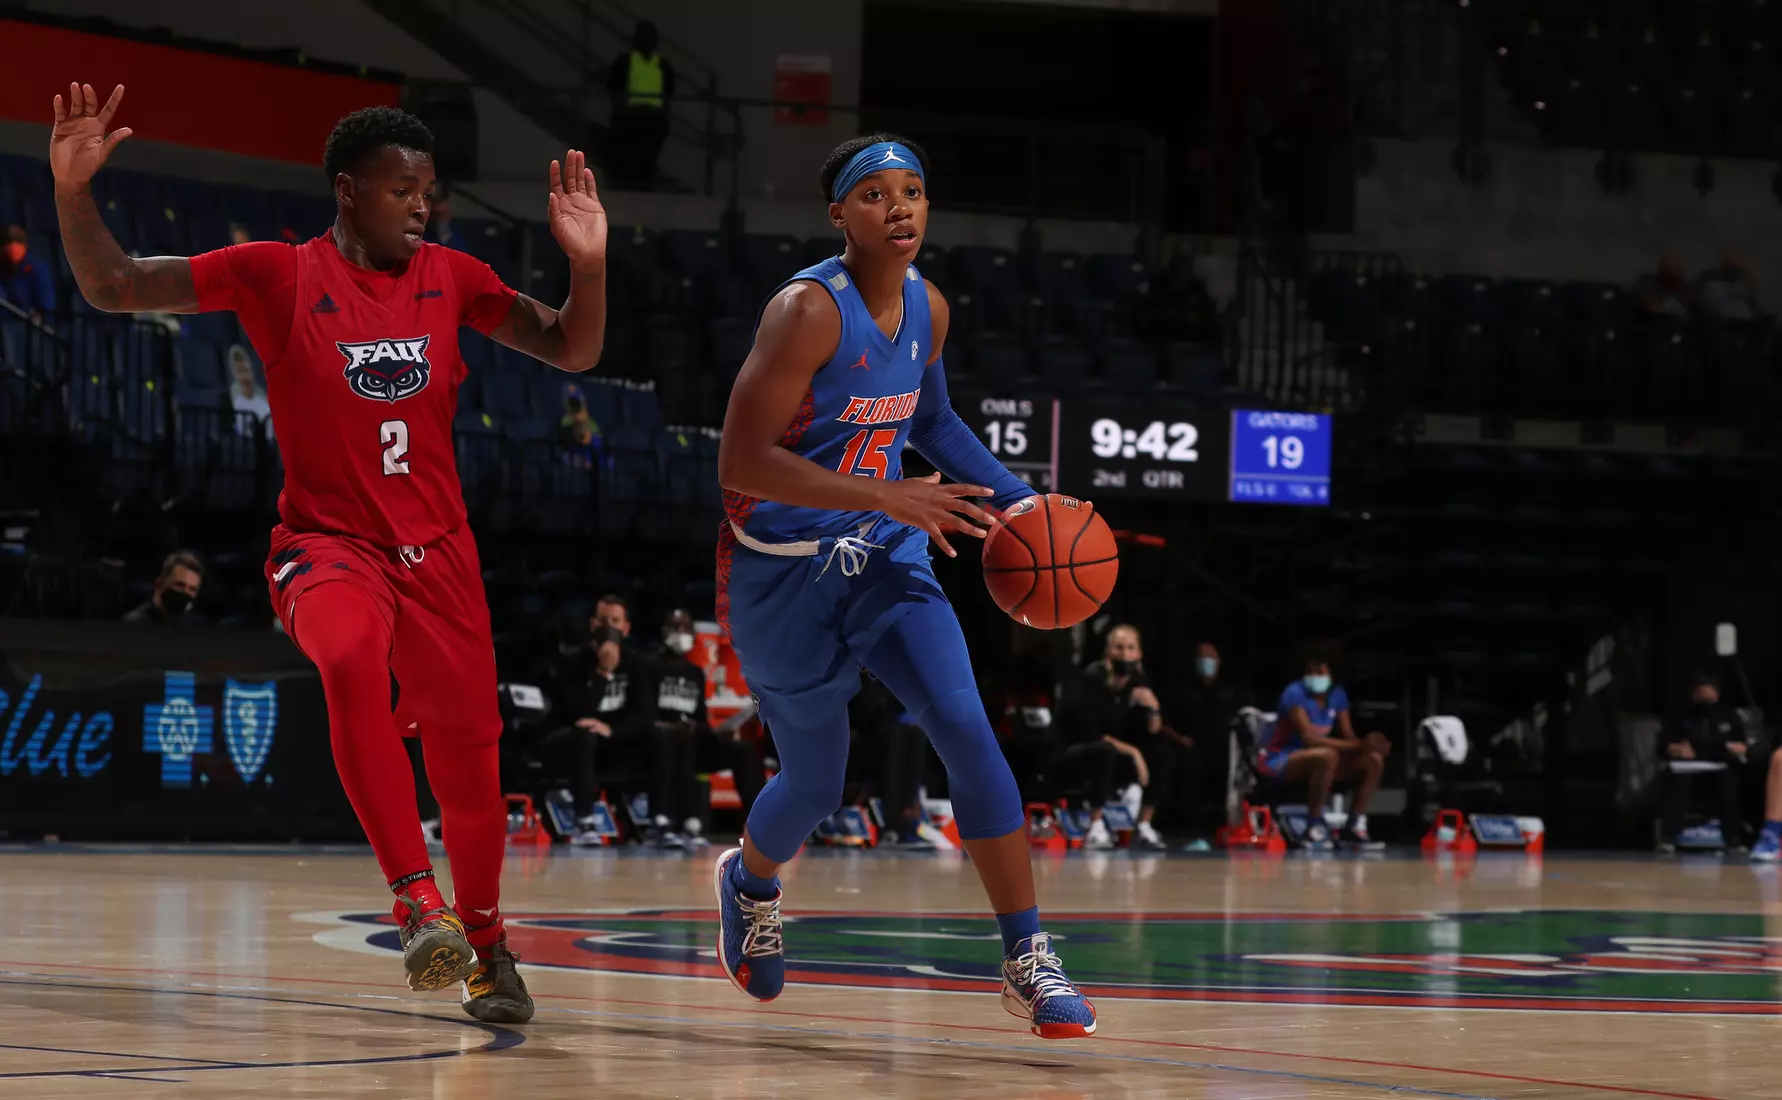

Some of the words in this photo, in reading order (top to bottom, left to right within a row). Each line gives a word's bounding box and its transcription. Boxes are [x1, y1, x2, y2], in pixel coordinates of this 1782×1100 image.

[343, 340, 427, 371] FAU
[379, 419, 410, 476] 2
[836, 428, 899, 479] 15
[984, 420, 1028, 456] 15
[1091, 418, 1199, 462] 9:42
[1260, 435, 1304, 470] 19
[0, 673, 114, 778] lue
